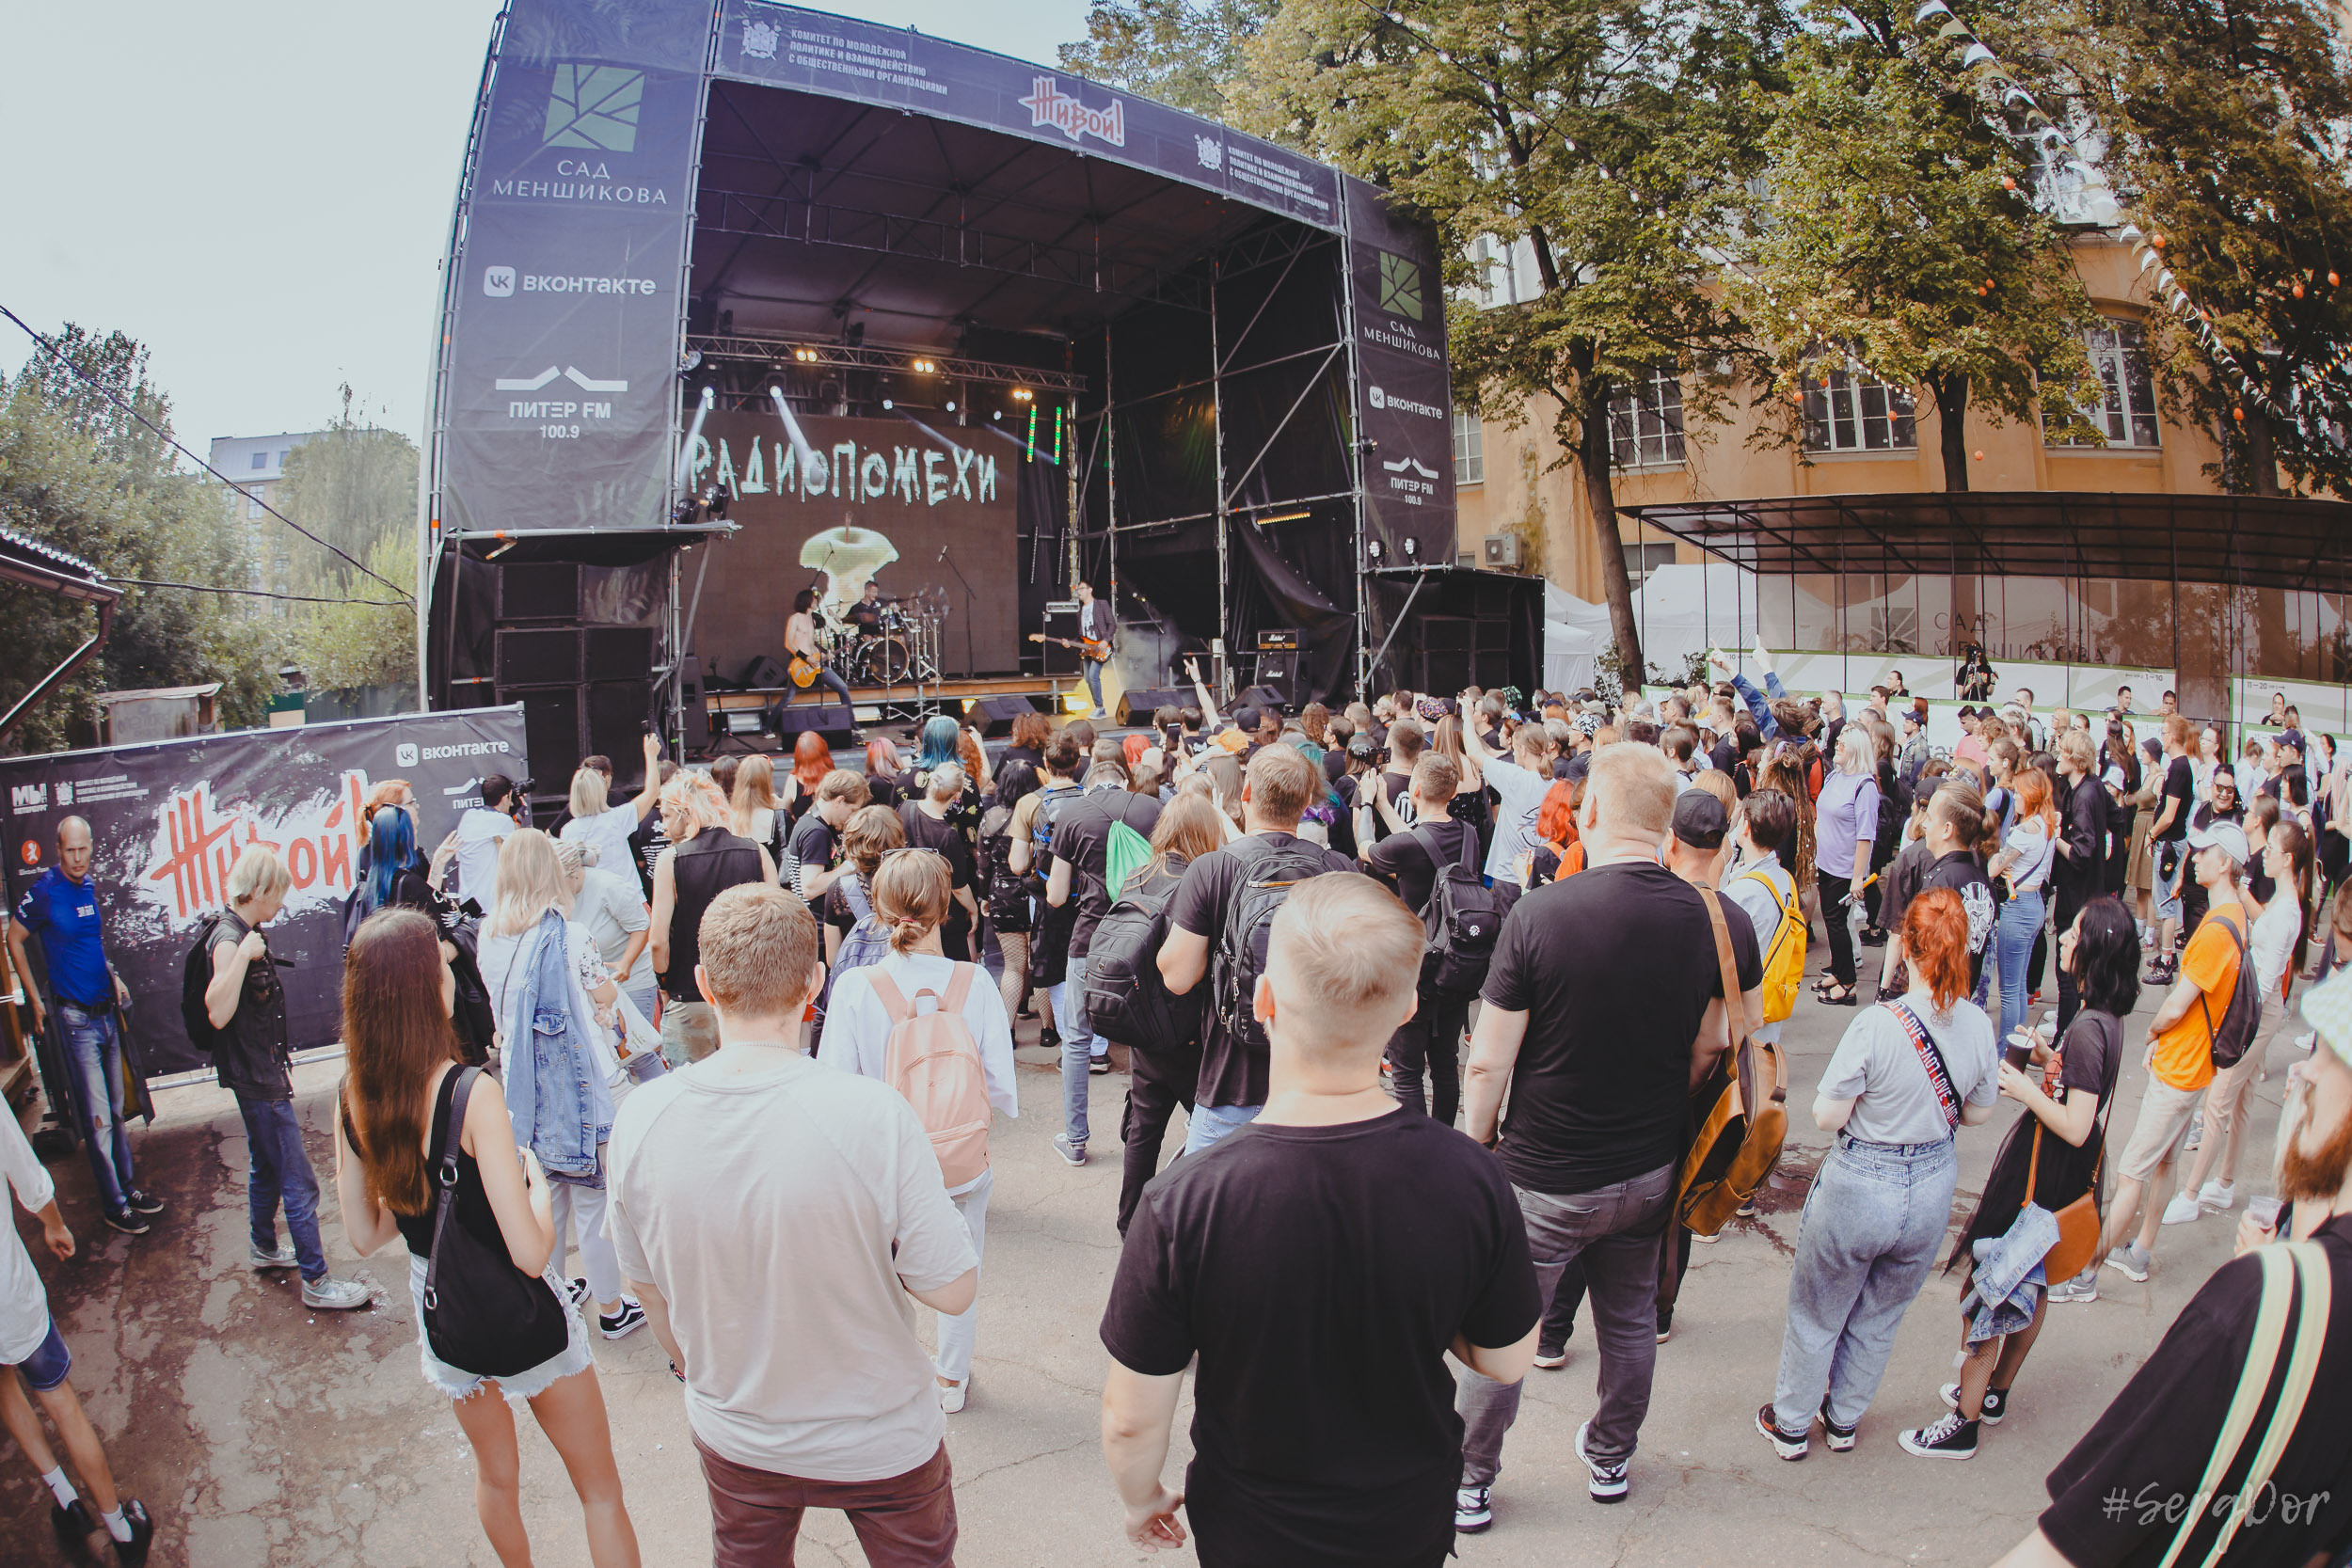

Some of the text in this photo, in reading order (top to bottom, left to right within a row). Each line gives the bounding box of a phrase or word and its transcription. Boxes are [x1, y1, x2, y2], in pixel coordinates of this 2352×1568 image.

[791, 29, 831, 45] КОМИТЕТ
[833, 37, 845, 48] ПО
[789, 40, 927, 77] ПОЛИТИКЕ И ВЗАИМОДЕЙСТВИЮ
[788, 54, 948, 96] С ОБЩЕСТВЕННЫМИ ОРГАНИЗАЦИЯМИ
[557, 159, 611, 180] САД
[493, 179, 668, 205] МЕНШИКОВА
[1390, 320, 1416, 340] САД
[1364, 326, 1440, 361] МЕНШИКОВА
[509, 401, 612, 420] ПИТЕР FM
[539, 423, 580, 439] 100.9
[690, 433, 997, 506] РАДИОПОМЕХИ
[1391, 477, 1434, 496] ПИТЕР FM
[1404, 494, 1422, 506] 100.9
[1899, 1010, 1926, 1044] LOVE
[1931, 1071, 1952, 1101] LOVE
